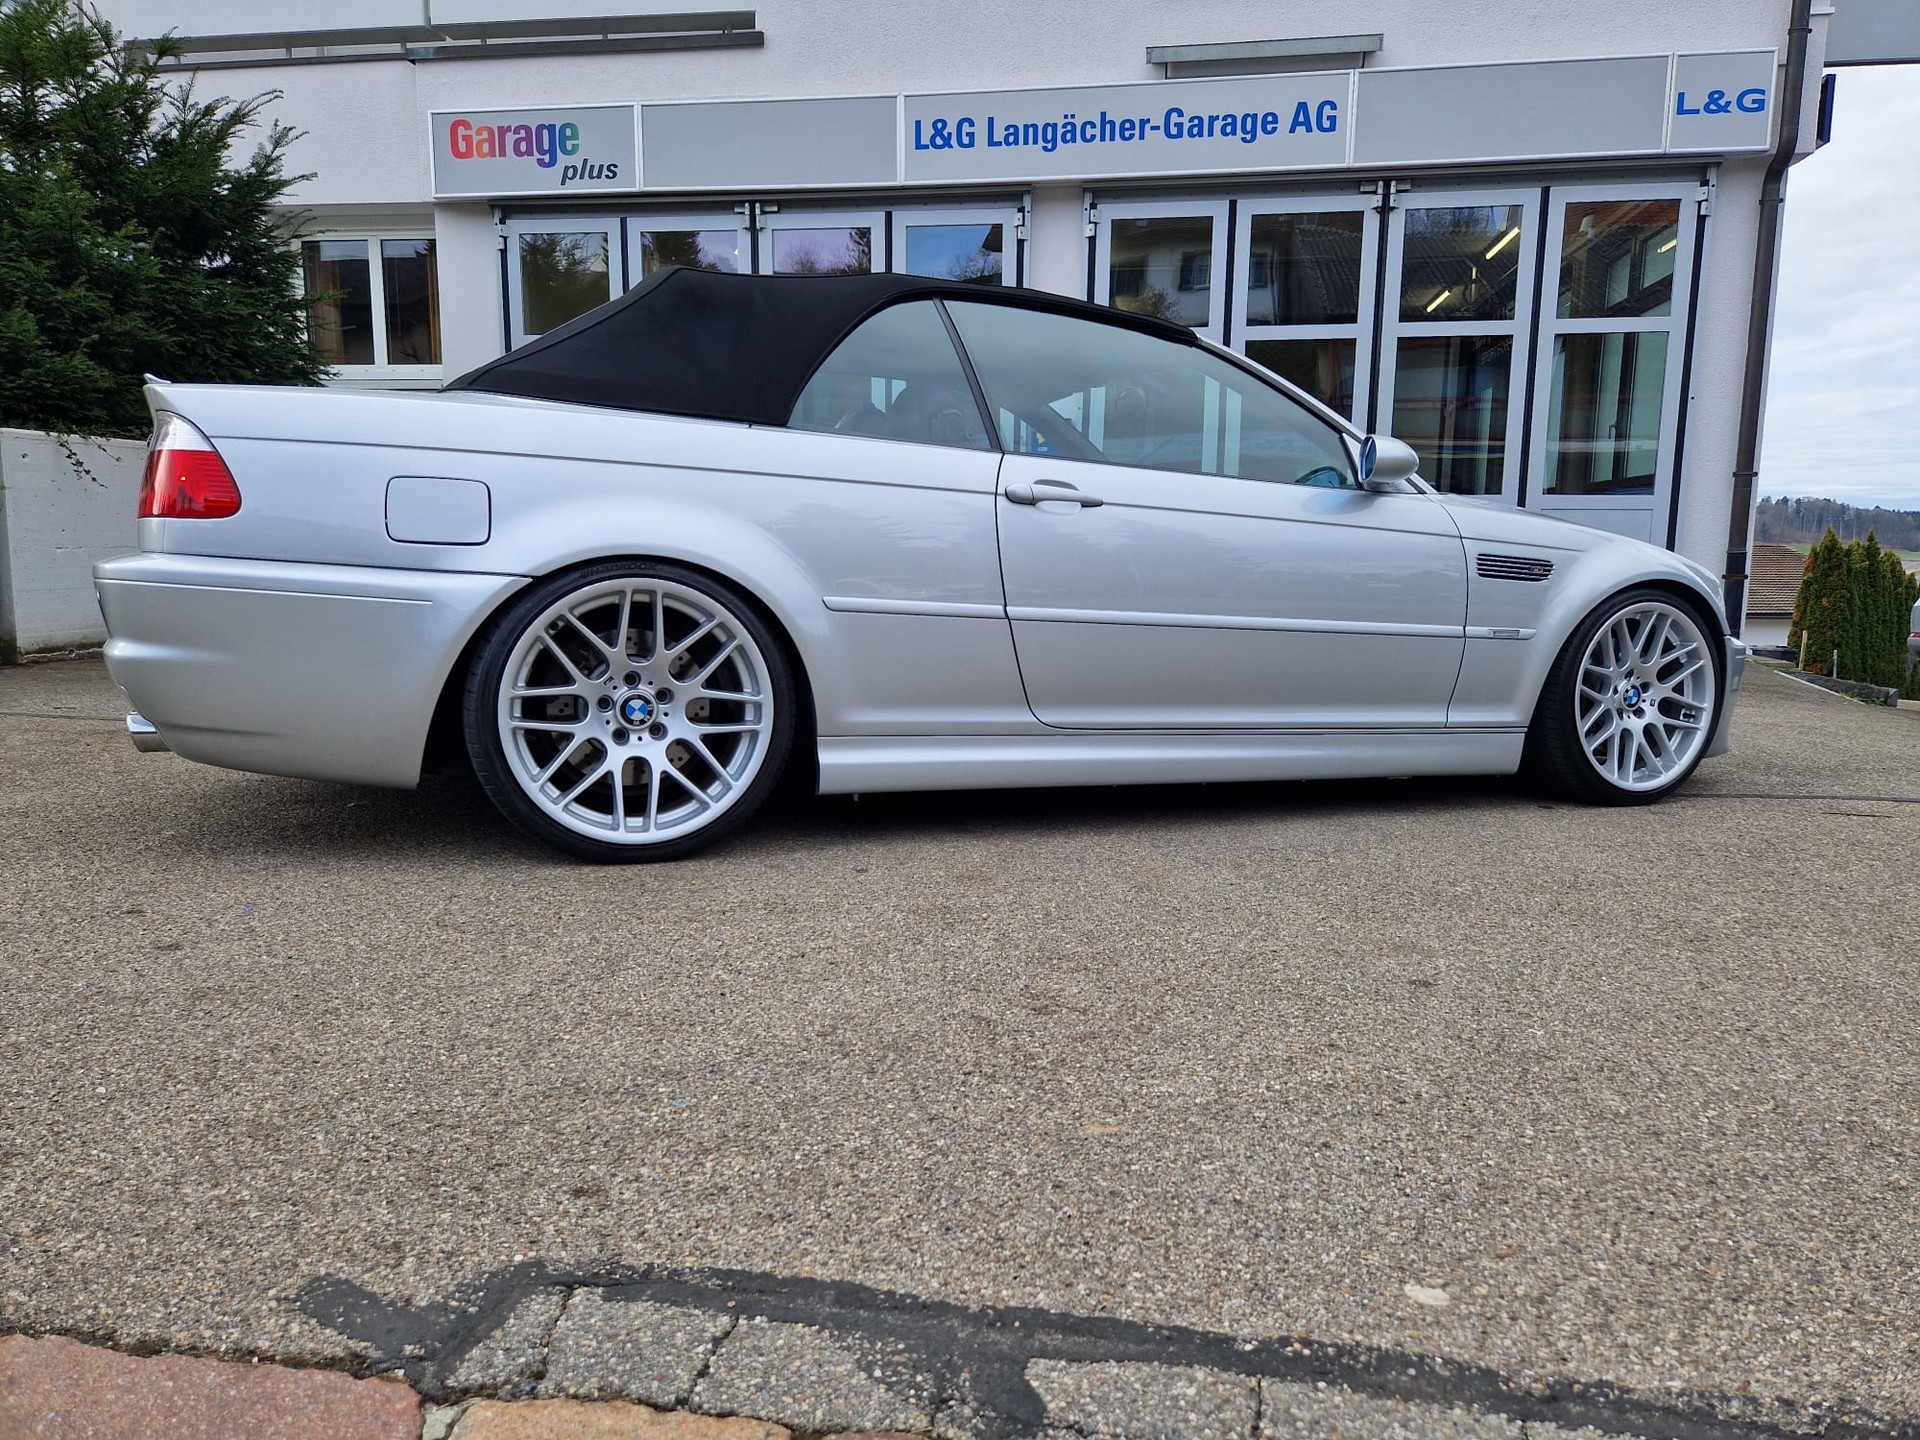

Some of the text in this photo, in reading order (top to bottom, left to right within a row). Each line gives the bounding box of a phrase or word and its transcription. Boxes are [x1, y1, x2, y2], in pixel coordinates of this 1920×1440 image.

[1676, 88, 1767, 116] L&G
[450, 118, 580, 168] Garage
[914, 99, 1338, 153] L&G Langächer-Garage AG
[560, 158, 619, 186] plus
